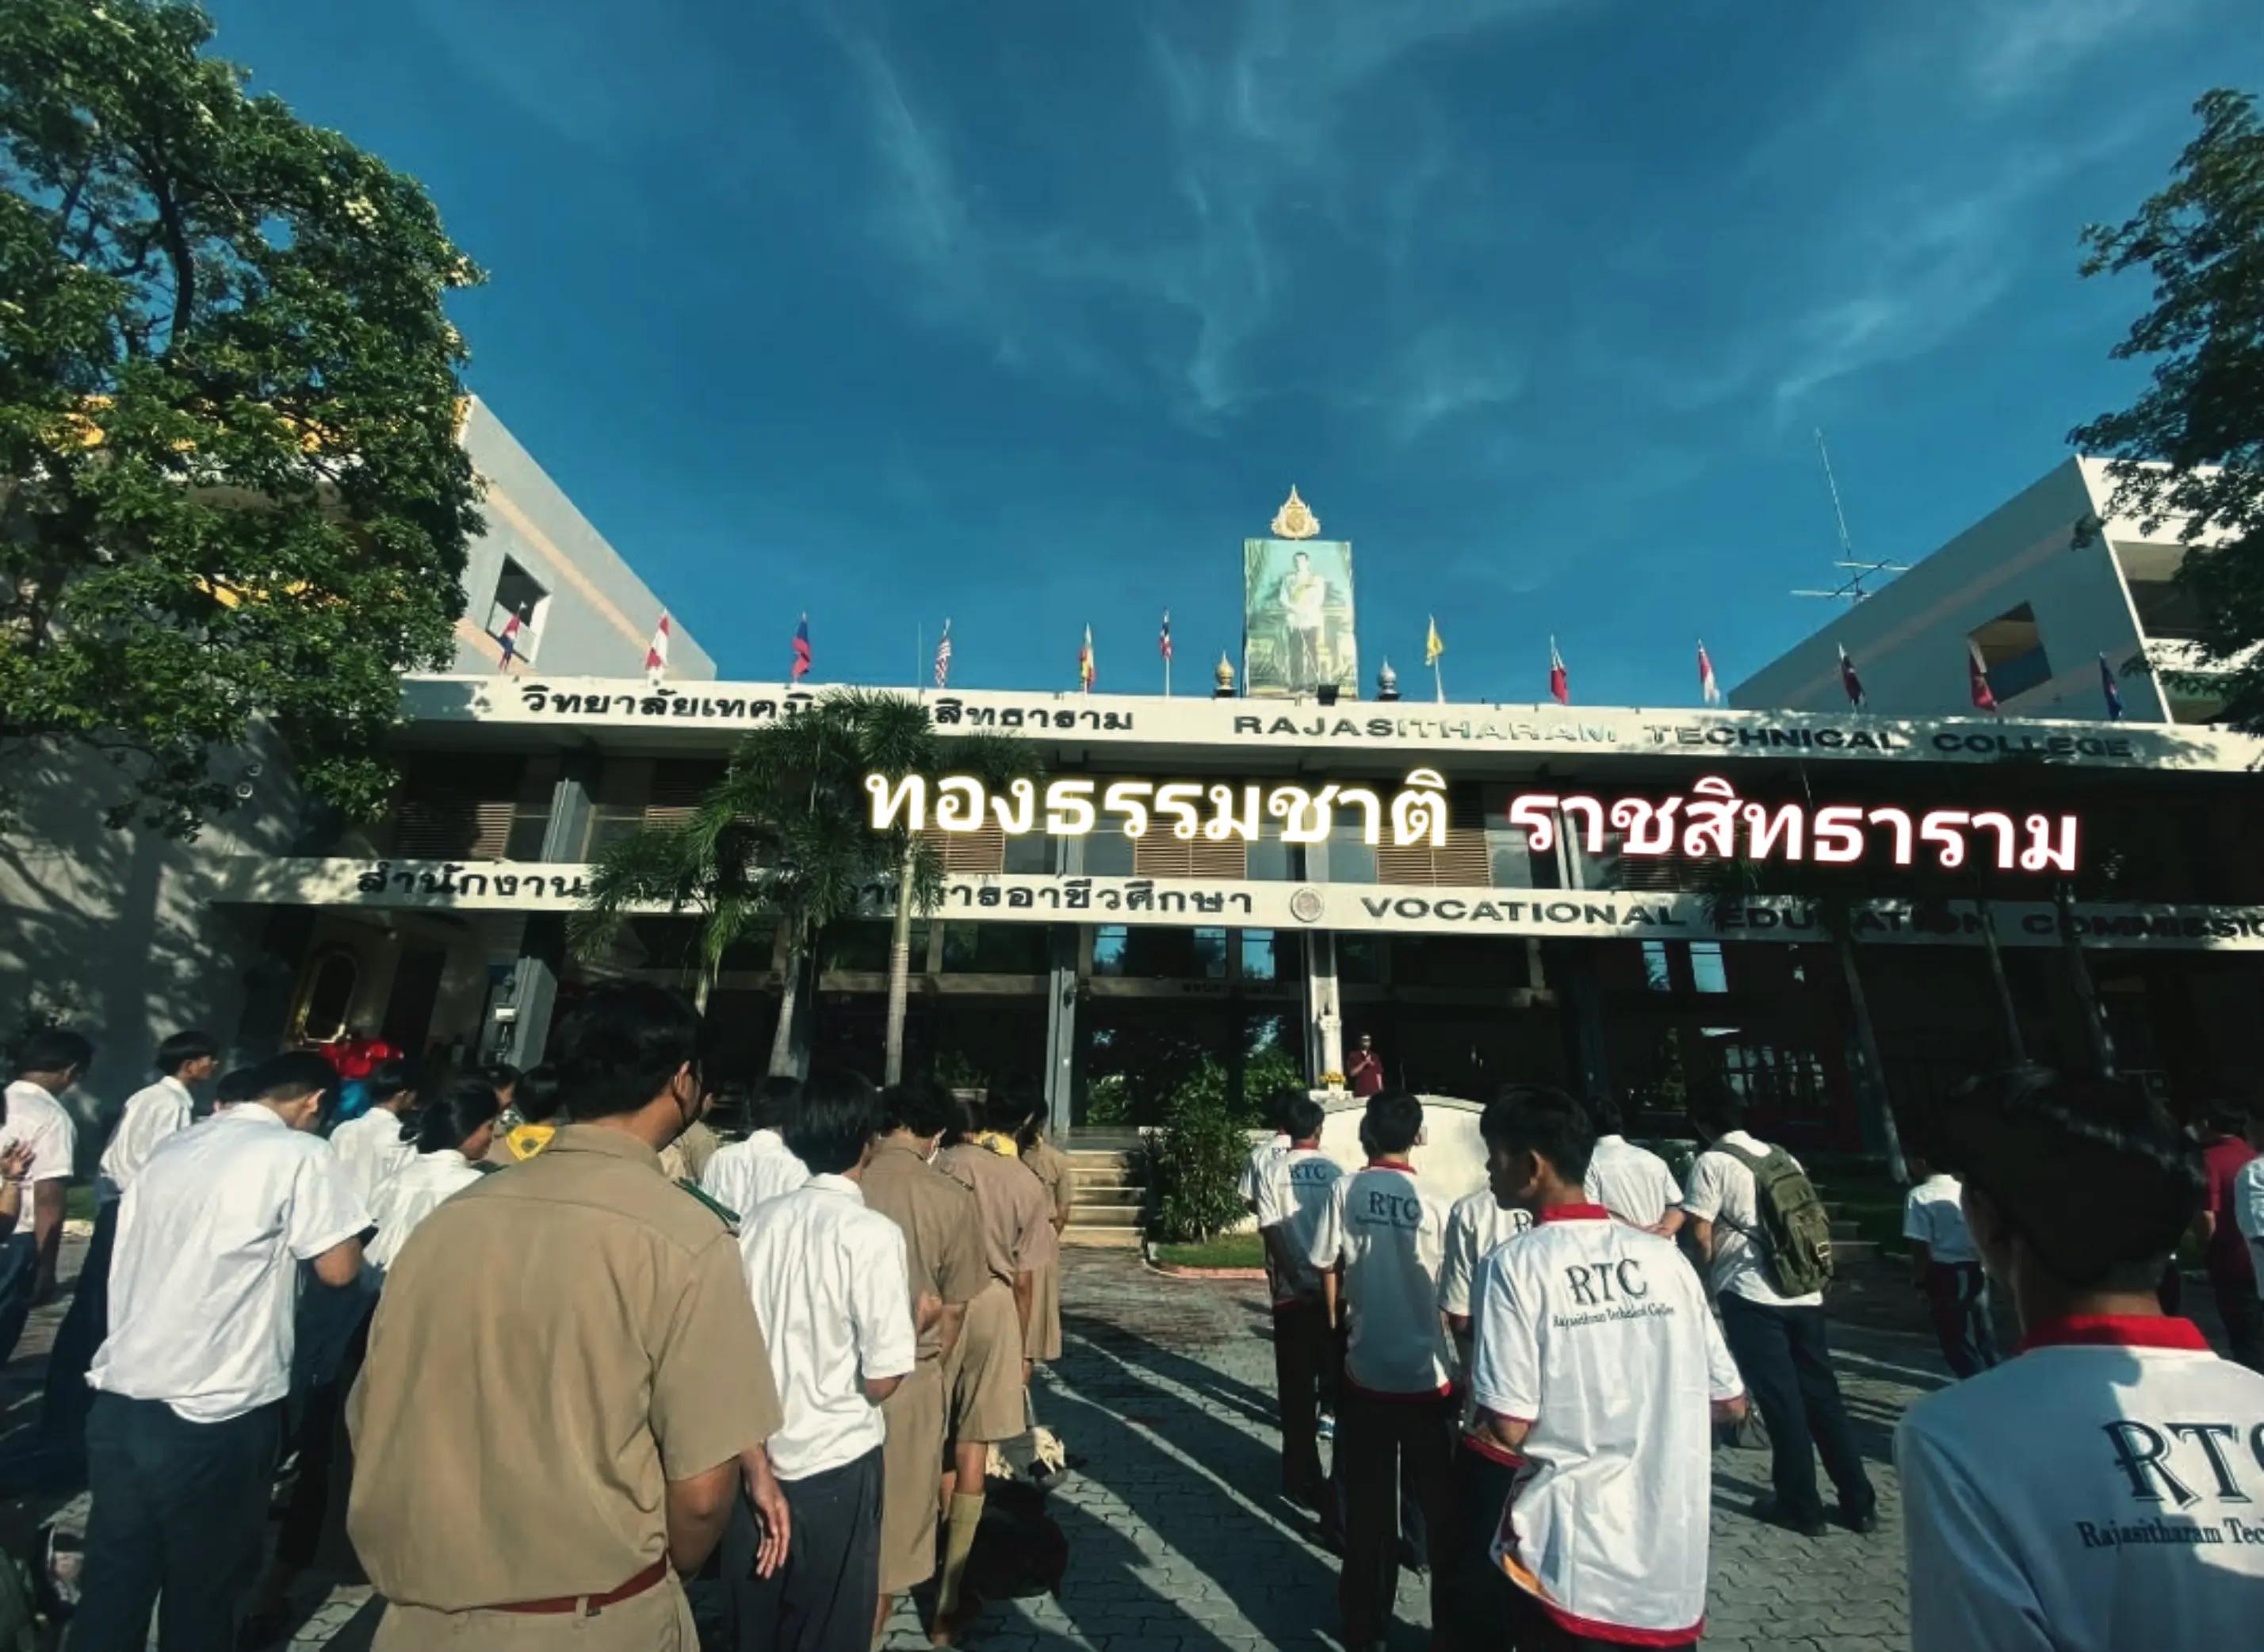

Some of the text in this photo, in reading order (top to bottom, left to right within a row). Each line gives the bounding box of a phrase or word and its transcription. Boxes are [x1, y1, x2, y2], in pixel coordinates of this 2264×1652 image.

[1233, 715, 2133, 757] RAJASITHARAM TECHNICAL COLLEGE
[1360, 897, 2264, 939] VOCATIONAL EDUATION COMMISSI
[1289, 1164, 1327, 1180] RTC
[1369, 1191, 1420, 1221] RTC
[1565, 1258, 1649, 1306] RTC
[2101, 1420, 2264, 1510] RT
[2075, 1516, 2224, 1552] Rajasitharam
